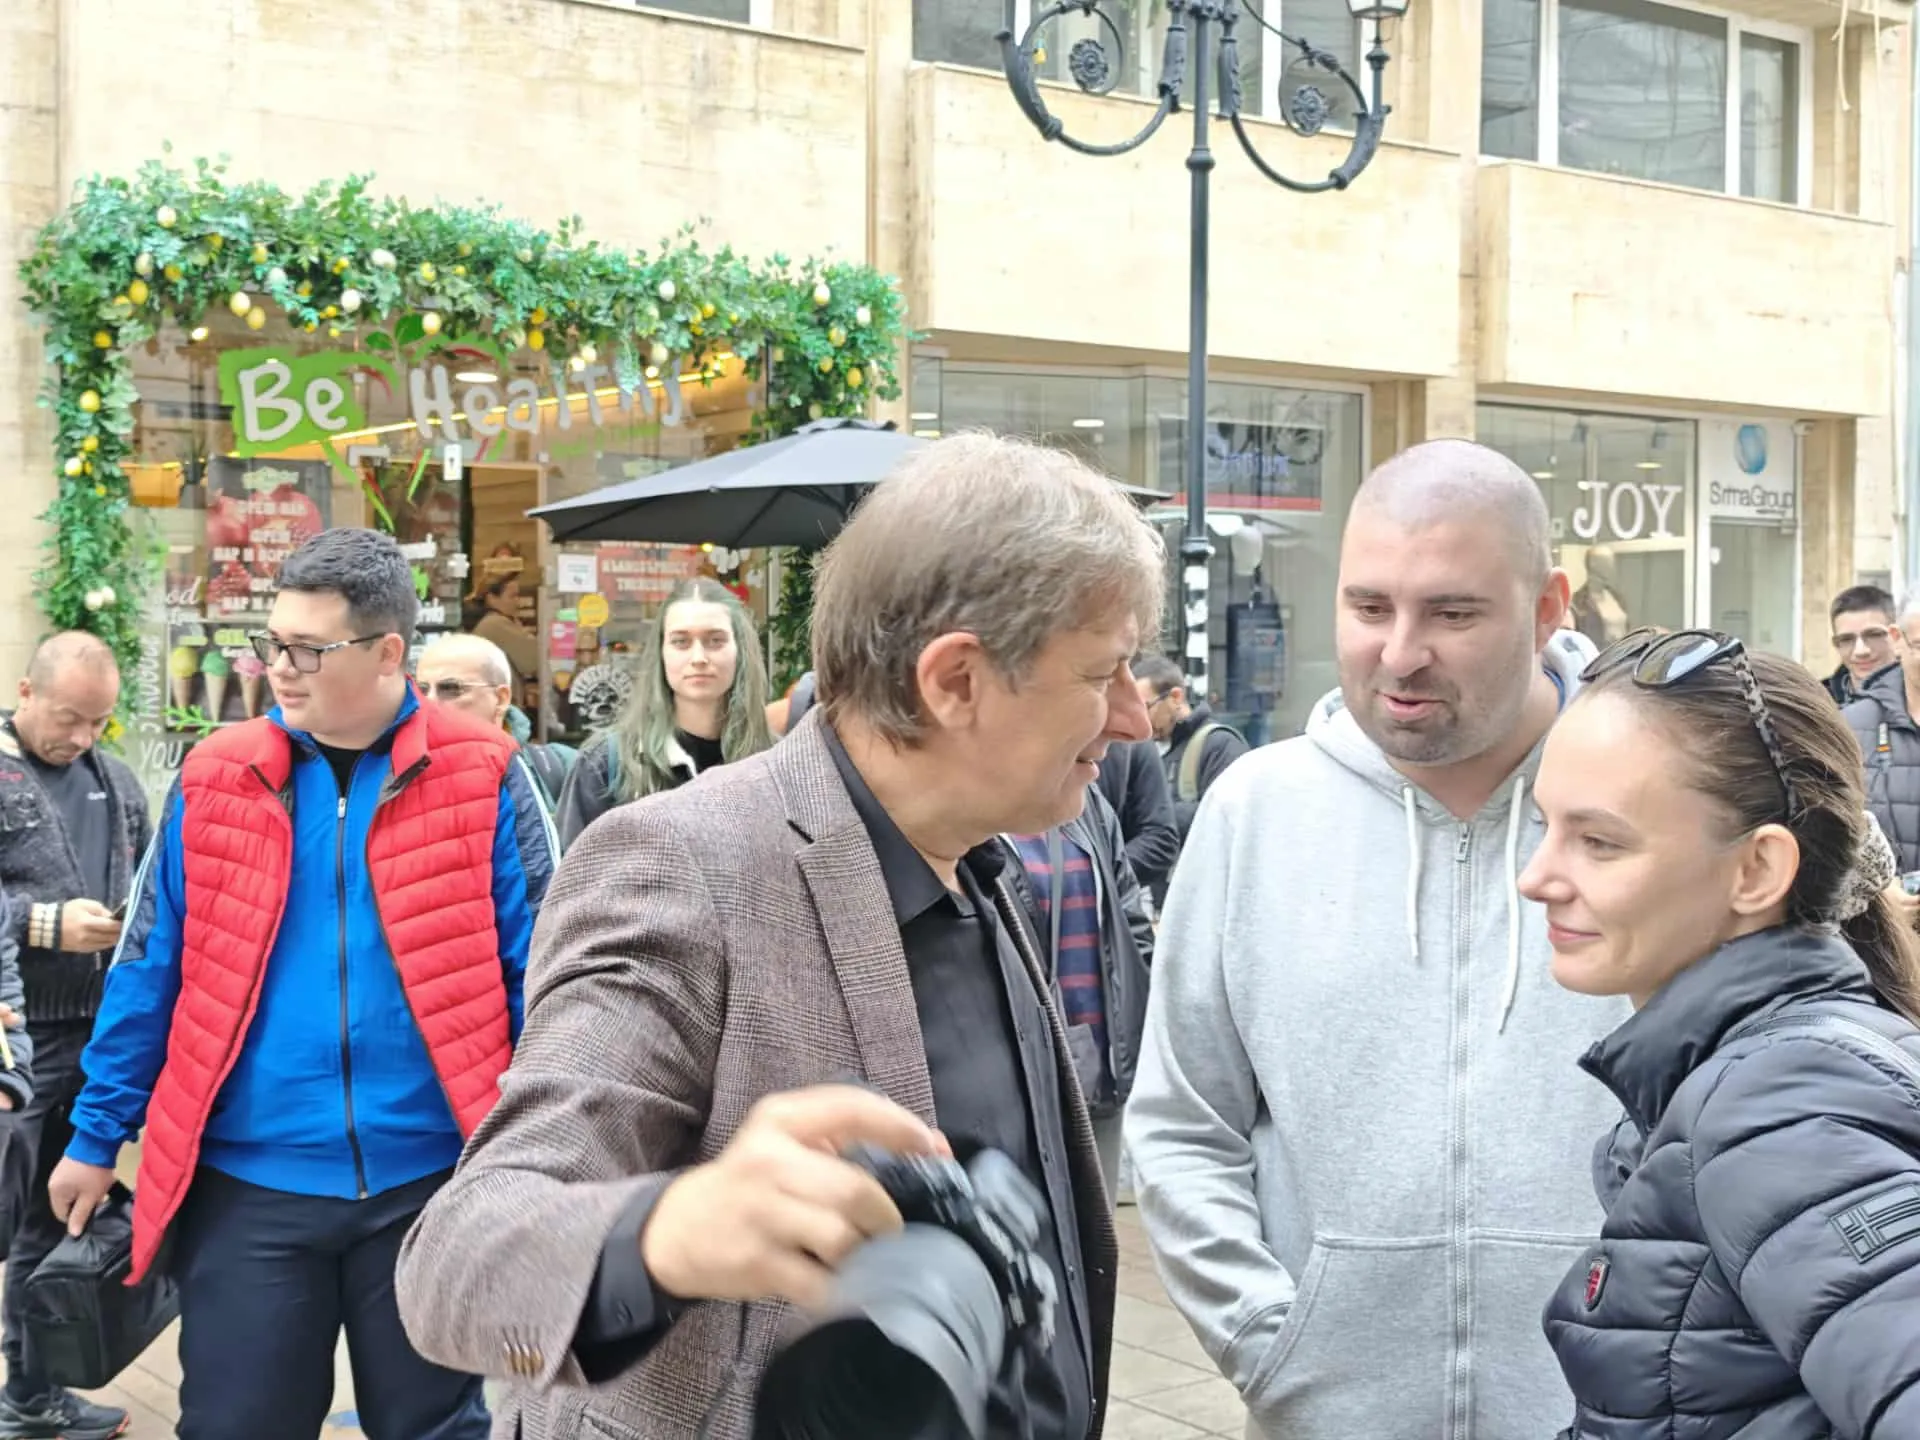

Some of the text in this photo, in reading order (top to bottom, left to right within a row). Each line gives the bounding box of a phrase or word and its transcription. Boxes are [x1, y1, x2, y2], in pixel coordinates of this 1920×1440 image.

[237, 360, 348, 442] Be
[1572, 482, 1682, 540] JOY
[139, 738, 184, 769] YOU
